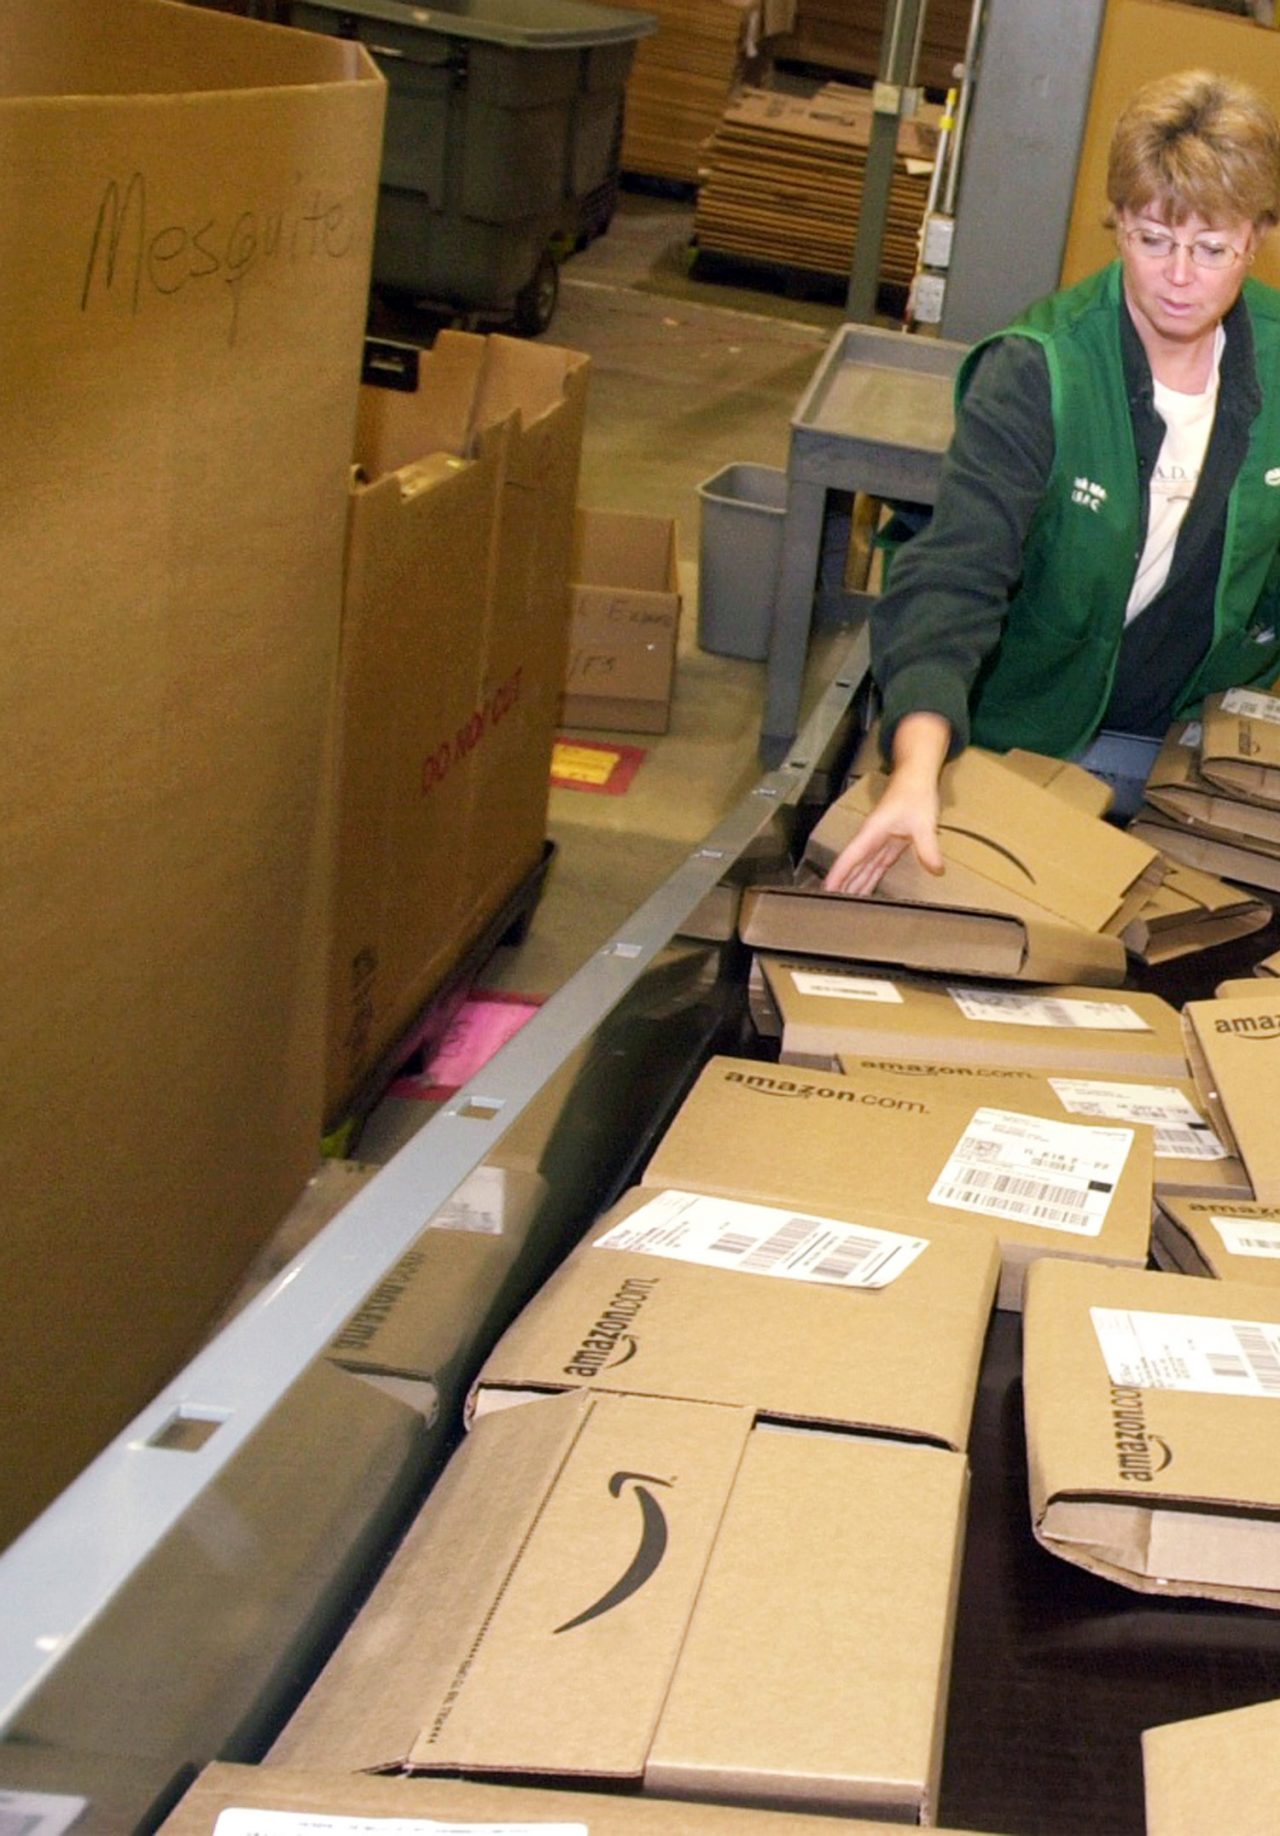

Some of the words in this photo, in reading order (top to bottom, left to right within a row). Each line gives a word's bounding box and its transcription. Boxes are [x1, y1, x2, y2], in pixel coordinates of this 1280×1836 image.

[724, 1071, 931, 1114] amazon.com
[860, 1060, 1036, 1080] amazon.com
[564, 1277, 662, 1377] amazon.com
[1110, 1381, 1153, 1482] amazon.co
